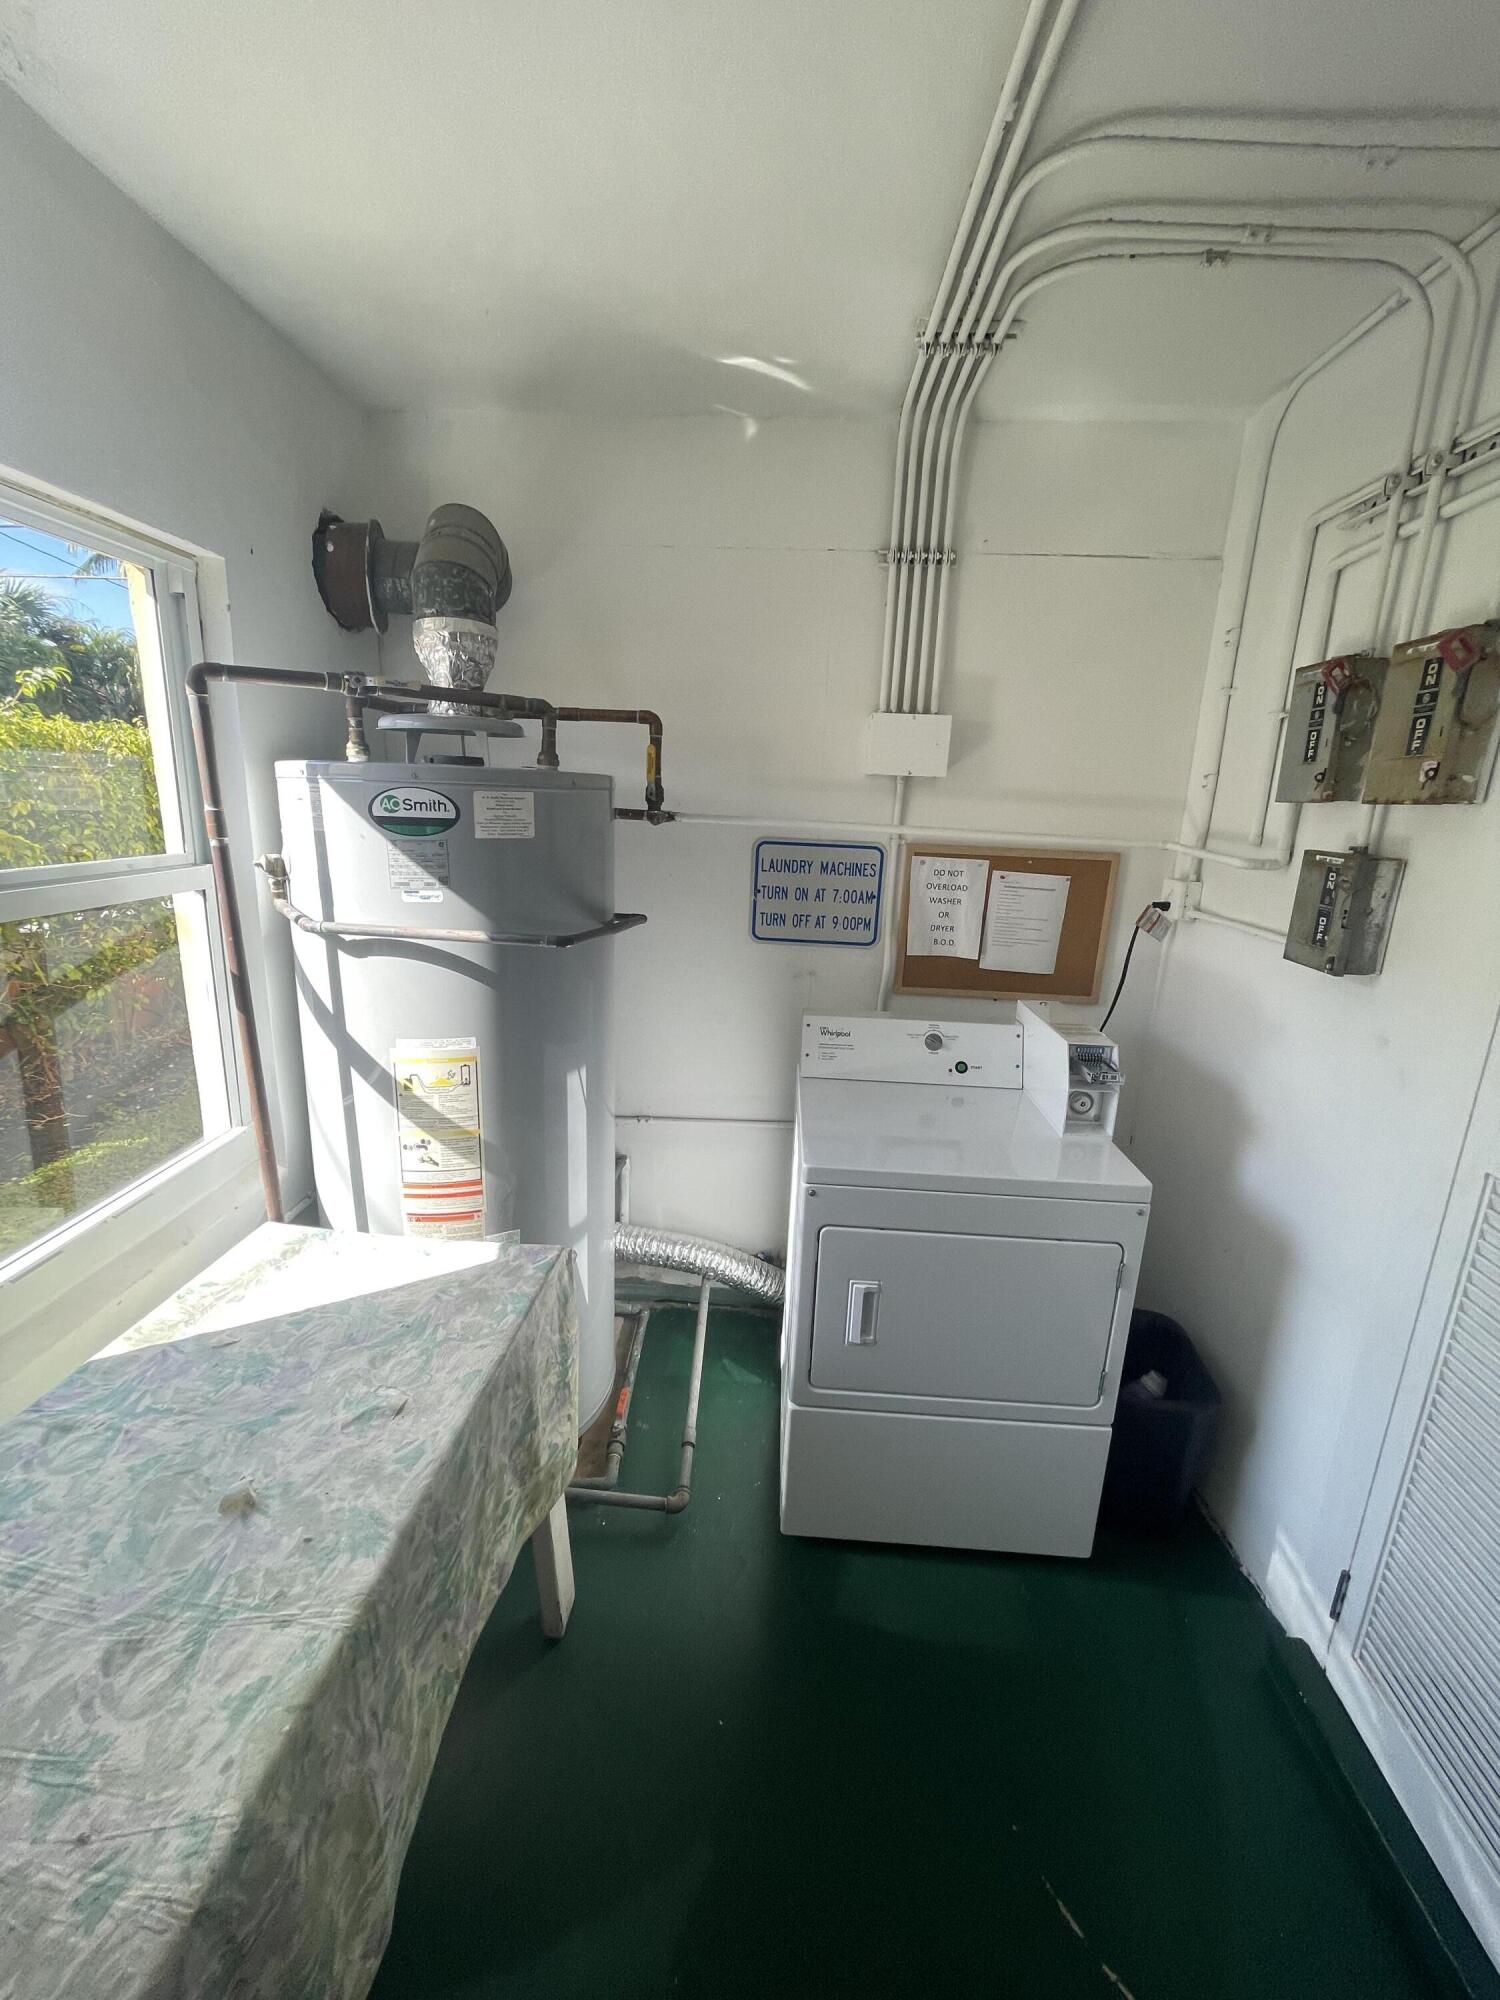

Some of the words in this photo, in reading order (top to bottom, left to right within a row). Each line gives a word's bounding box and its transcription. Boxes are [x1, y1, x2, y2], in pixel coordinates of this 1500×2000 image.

[402, 798, 447, 812] Smith
[761, 858, 814, 875] LAUNDRY
[820, 861, 877, 878] MACHINES
[933, 868, 946, 877] DO
[947, 869, 965, 878] NOT
[926, 882, 968, 892] OVERLOAD
[761, 885, 788, 900] TURN
[794, 887, 809, 902] ON
[814, 888, 826, 903] AT
[833, 888, 874, 905] 7:00AM
[929, 897, 962, 905] WASHER
[760, 912, 786, 927] TURN
[792, 913, 812, 928] OFF
[814, 915, 826, 929] AT
[930, 924, 955, 932] DRYER
[820, 1029, 851, 1038] Whirlpool
